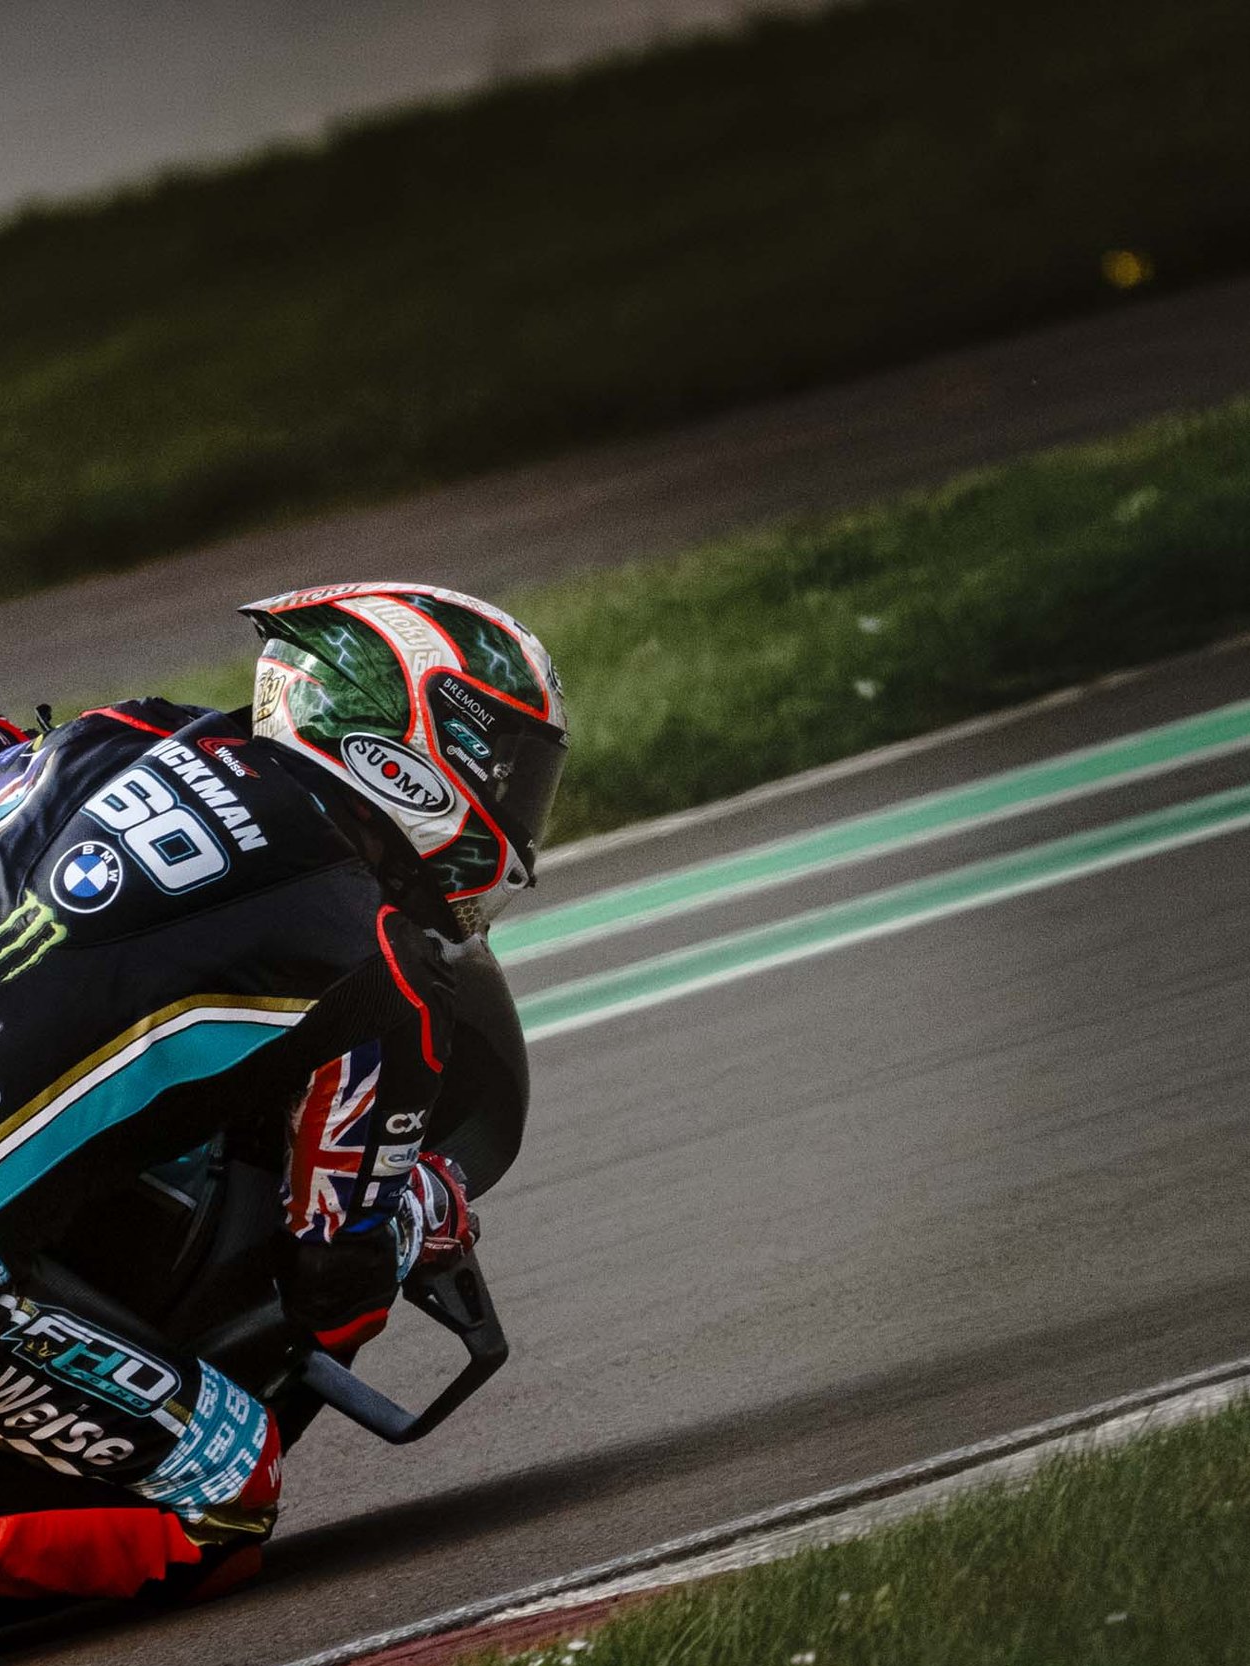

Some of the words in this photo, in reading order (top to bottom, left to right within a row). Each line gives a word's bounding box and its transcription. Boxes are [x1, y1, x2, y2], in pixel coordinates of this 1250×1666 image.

[443, 678, 495, 725] BREMONT
[214, 746, 246, 777] Weise
[81, 766, 230, 894] 60
[22, 1314, 177, 1402] FHO
[62, 1363, 147, 1409] RACING
